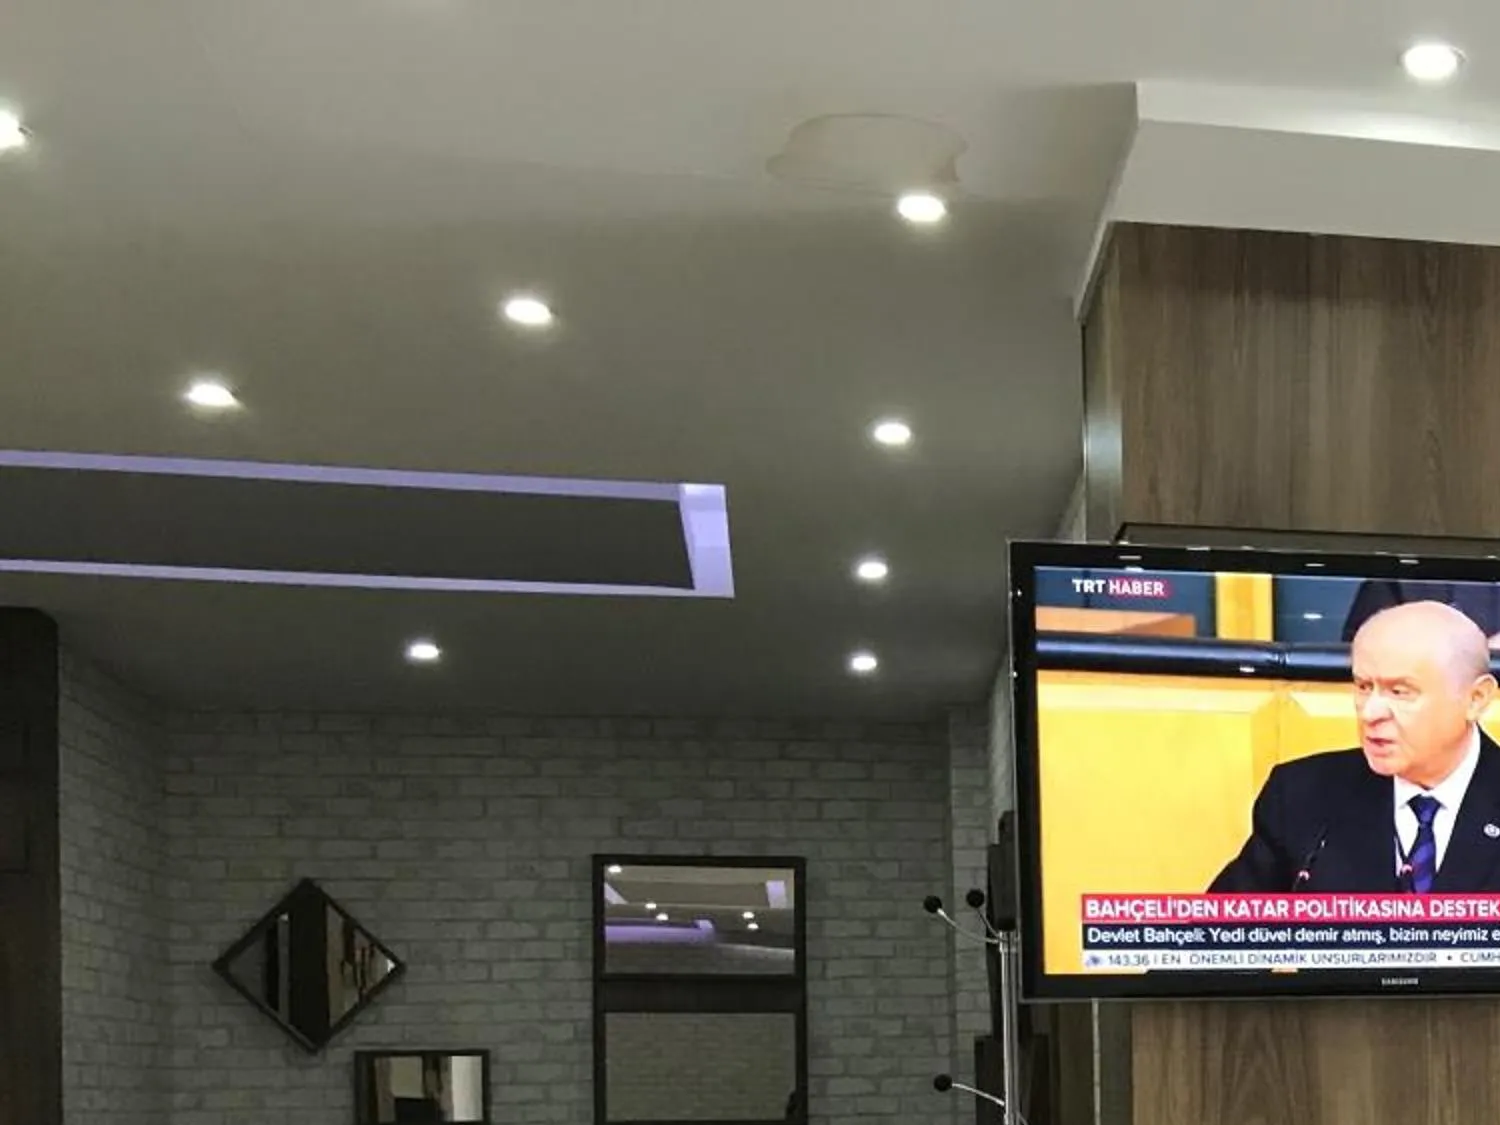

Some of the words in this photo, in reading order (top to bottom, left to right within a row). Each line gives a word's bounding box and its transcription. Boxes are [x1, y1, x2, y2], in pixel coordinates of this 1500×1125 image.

[1072, 578, 1106, 593] TRT
[1108, 579, 1165, 596] HABER
[1087, 896, 1218, 922] BAHÇELİ'DEN
[1224, 899, 1289, 918] KATAR
[1294, 896, 1425, 918] POLİTİKASINA
[1429, 899, 1500, 917] DESTEK
[1087, 927, 1141, 944] Devlet
[1209, 927, 1245, 943] Yedi
[1248, 926, 1291, 943] düvel
[1295, 926, 1339, 943] demir
[1390, 926, 1430, 942] bizim
[1432, 927, 1489, 944] neyimiz
[1161, 952, 1181, 965] EN
